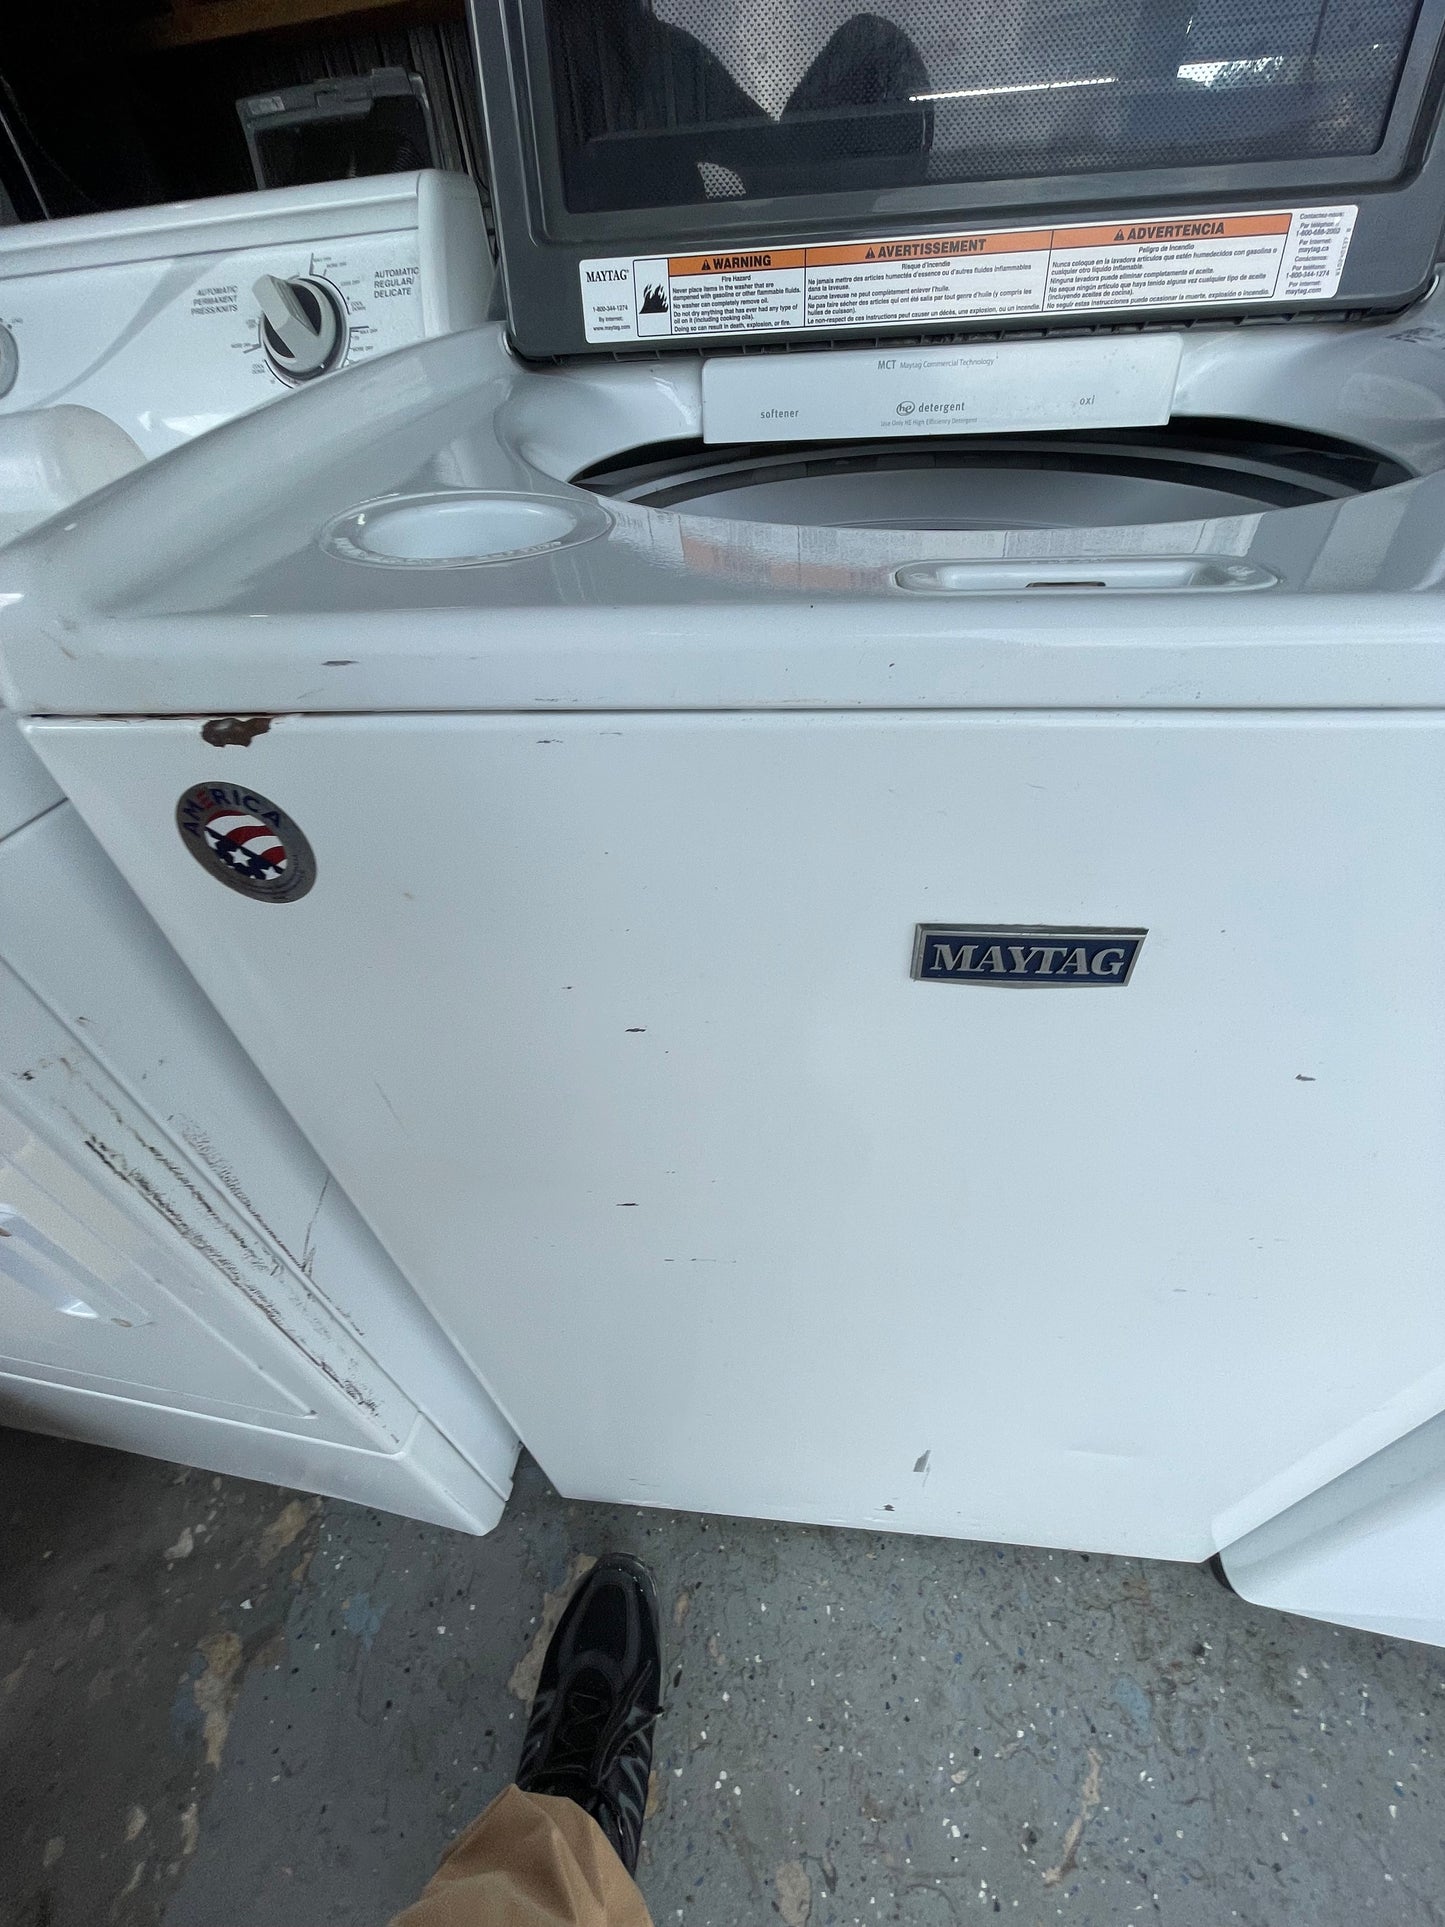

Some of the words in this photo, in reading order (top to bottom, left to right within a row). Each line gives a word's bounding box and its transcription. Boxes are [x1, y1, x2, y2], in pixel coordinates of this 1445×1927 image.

[1127, 222, 1225, 239] ADVERTENCIA
[878, 239, 986, 256] AVERTISSEMENT
[713, 256, 770, 268] WARNING
[375, 266, 419, 278] AUTOMATIC
[586, 270, 627, 282] MAYTAG
[1143, 270, 1187, 278] completamente
[374, 277, 414, 288] REGULAR/
[374, 288, 411, 298] DELICATE
[878, 360, 896, 369] MCT
[900, 361, 922, 370] Maytag
[923, 360, 958, 368] Commercial
[960, 358, 994, 368] Technology
[1080, 395, 1095, 405] oxi
[918, 402, 965, 413] detergent
[761, 409, 799, 419] softener
[183, 788, 280, 837] AMERICA
[930, 944, 1125, 976] MAYTAG
